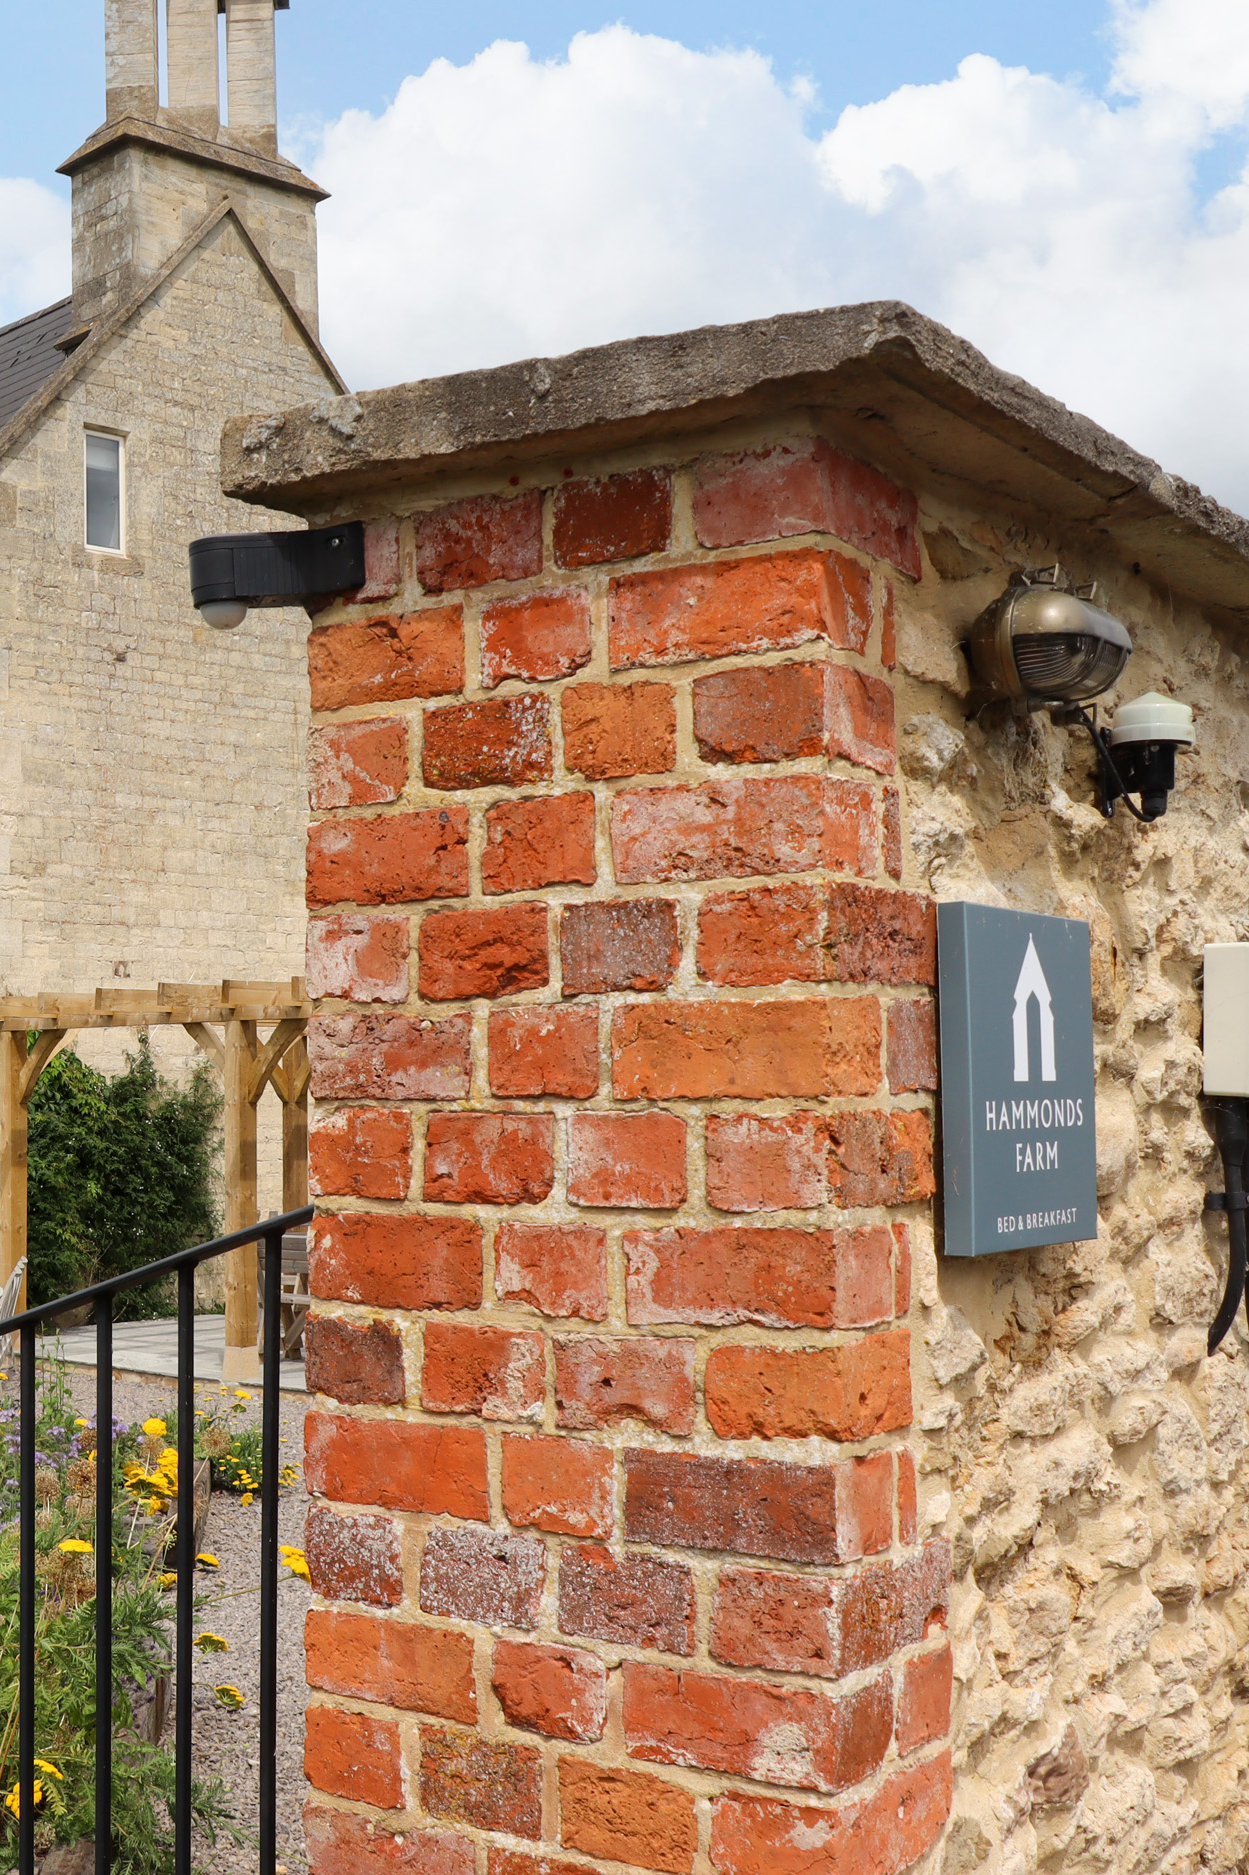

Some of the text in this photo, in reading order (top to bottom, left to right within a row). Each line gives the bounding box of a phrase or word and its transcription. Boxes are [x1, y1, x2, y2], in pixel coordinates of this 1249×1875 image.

[985, 1098, 1083, 1131] HAMMONDS
[1015, 1141, 1059, 1172] FARM
[997, 1207, 1077, 1233] BED & BREAKFAST
